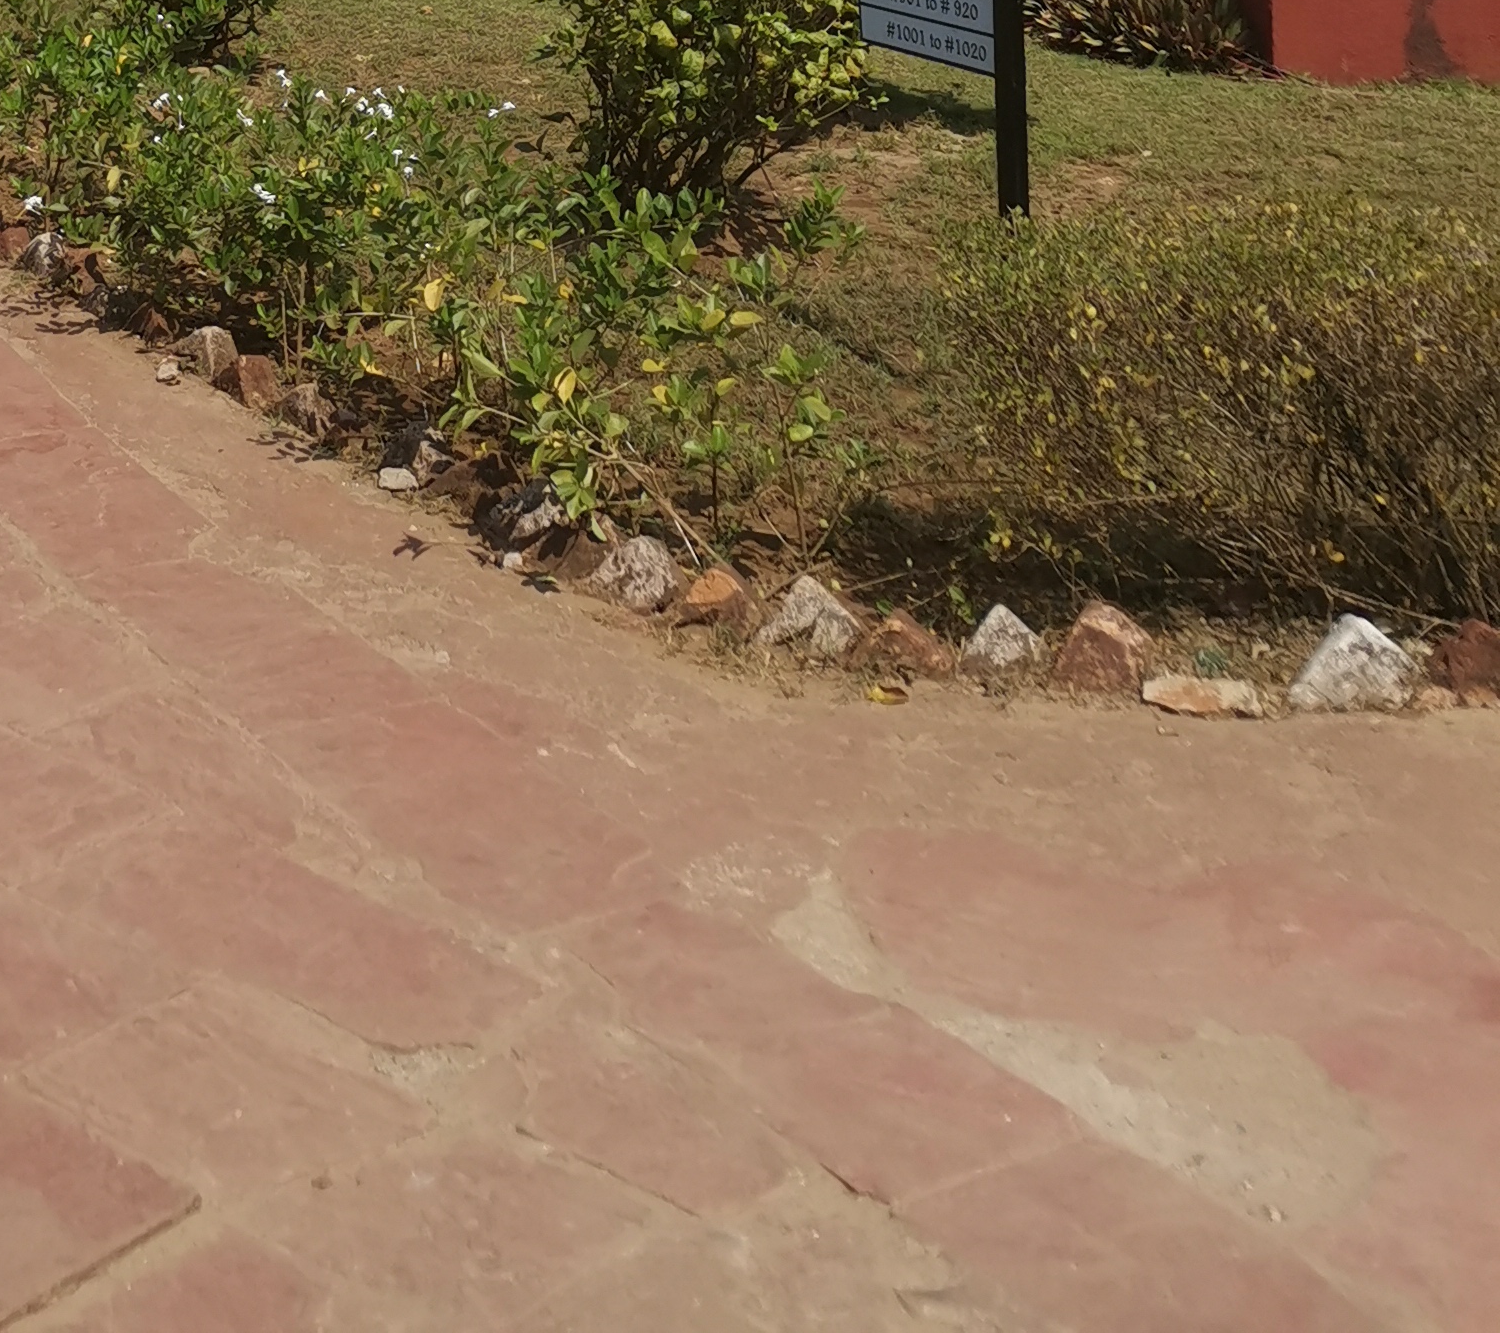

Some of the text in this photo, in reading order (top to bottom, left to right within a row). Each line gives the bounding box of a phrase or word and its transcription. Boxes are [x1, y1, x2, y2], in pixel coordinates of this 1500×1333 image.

[887, 21, 987, 62] #1001 to #1020
